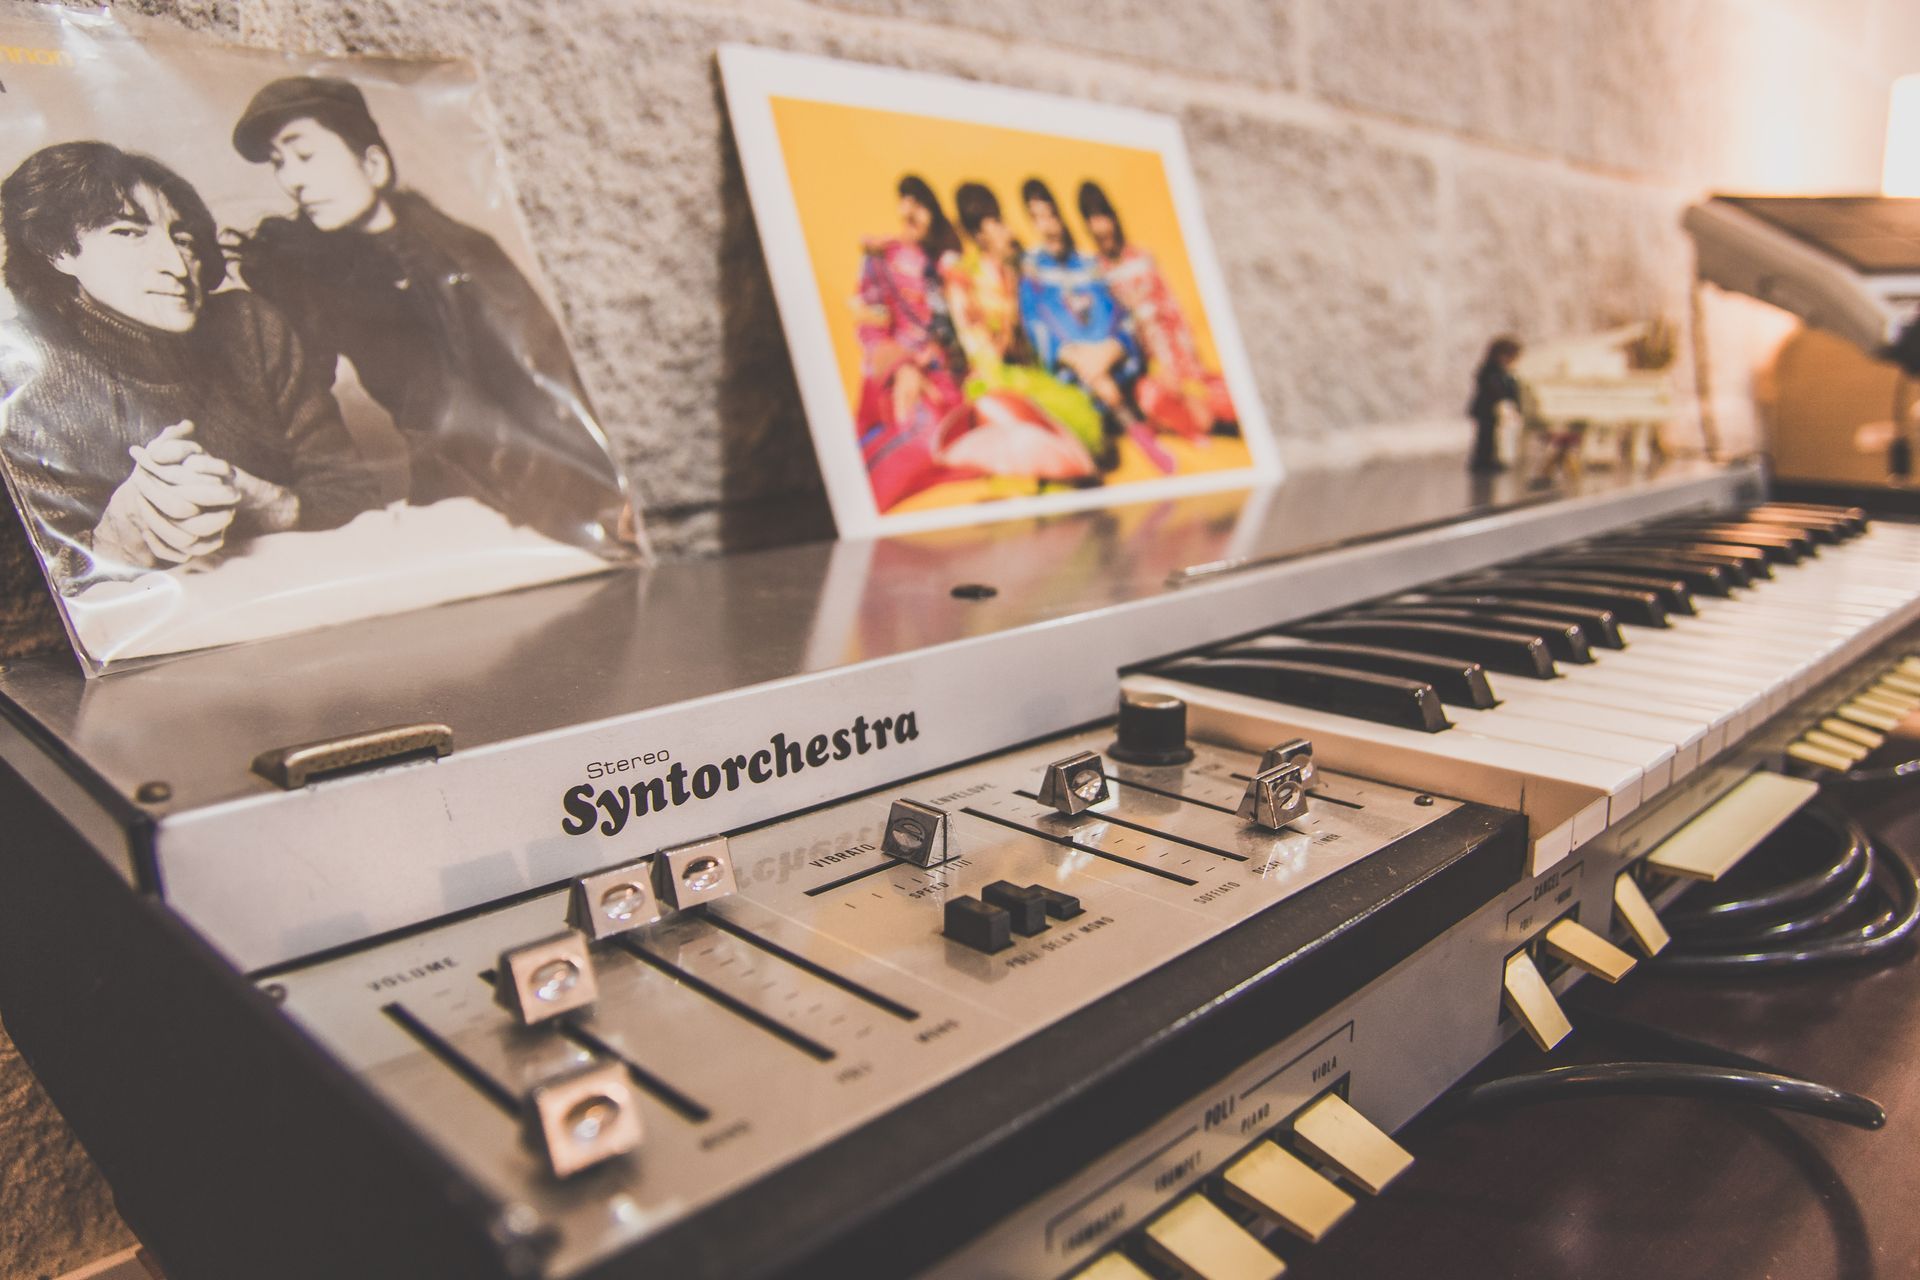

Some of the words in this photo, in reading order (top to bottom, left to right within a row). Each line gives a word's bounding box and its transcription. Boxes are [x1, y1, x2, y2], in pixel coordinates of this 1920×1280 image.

[561, 711, 919, 837] Syntorchestra
[586, 749, 670, 779] Stereo
[929, 783, 998, 806] ENVELOPE
[809, 843, 876, 868] VIBRATO
[909, 882, 950, 899] SPEED
[1193, 880, 1241, 905] SOFFIATO
[366, 956, 459, 992] VOLUME
[1312, 1055, 1338, 1083] VIOLA
[1204, 1093, 1236, 1133] POLI
[1241, 1102, 1270, 1135] PIANO
